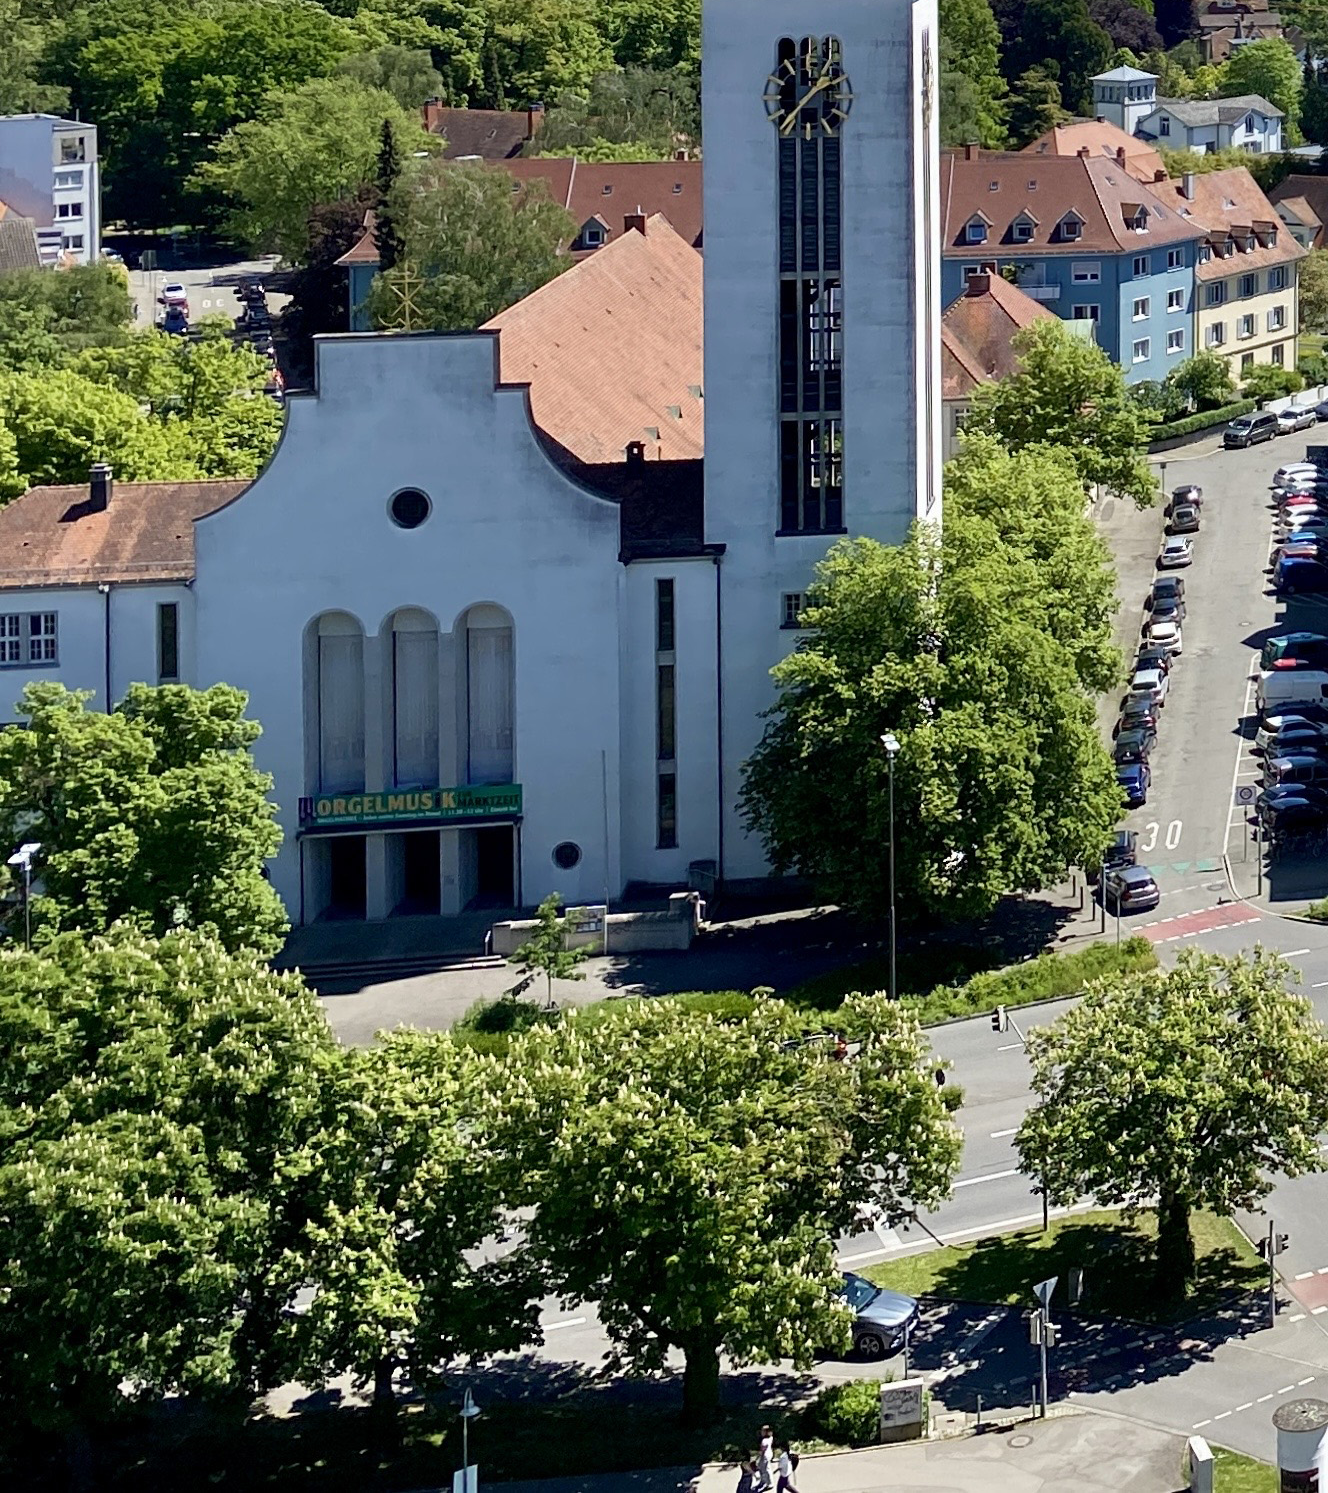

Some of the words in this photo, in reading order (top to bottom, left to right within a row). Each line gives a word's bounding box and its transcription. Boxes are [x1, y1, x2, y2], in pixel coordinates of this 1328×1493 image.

[317, 792, 456, 816] ORGELMUSIK
[458, 794, 519, 807] MARKTZEIT
[1141, 819, 1183, 852] 30
